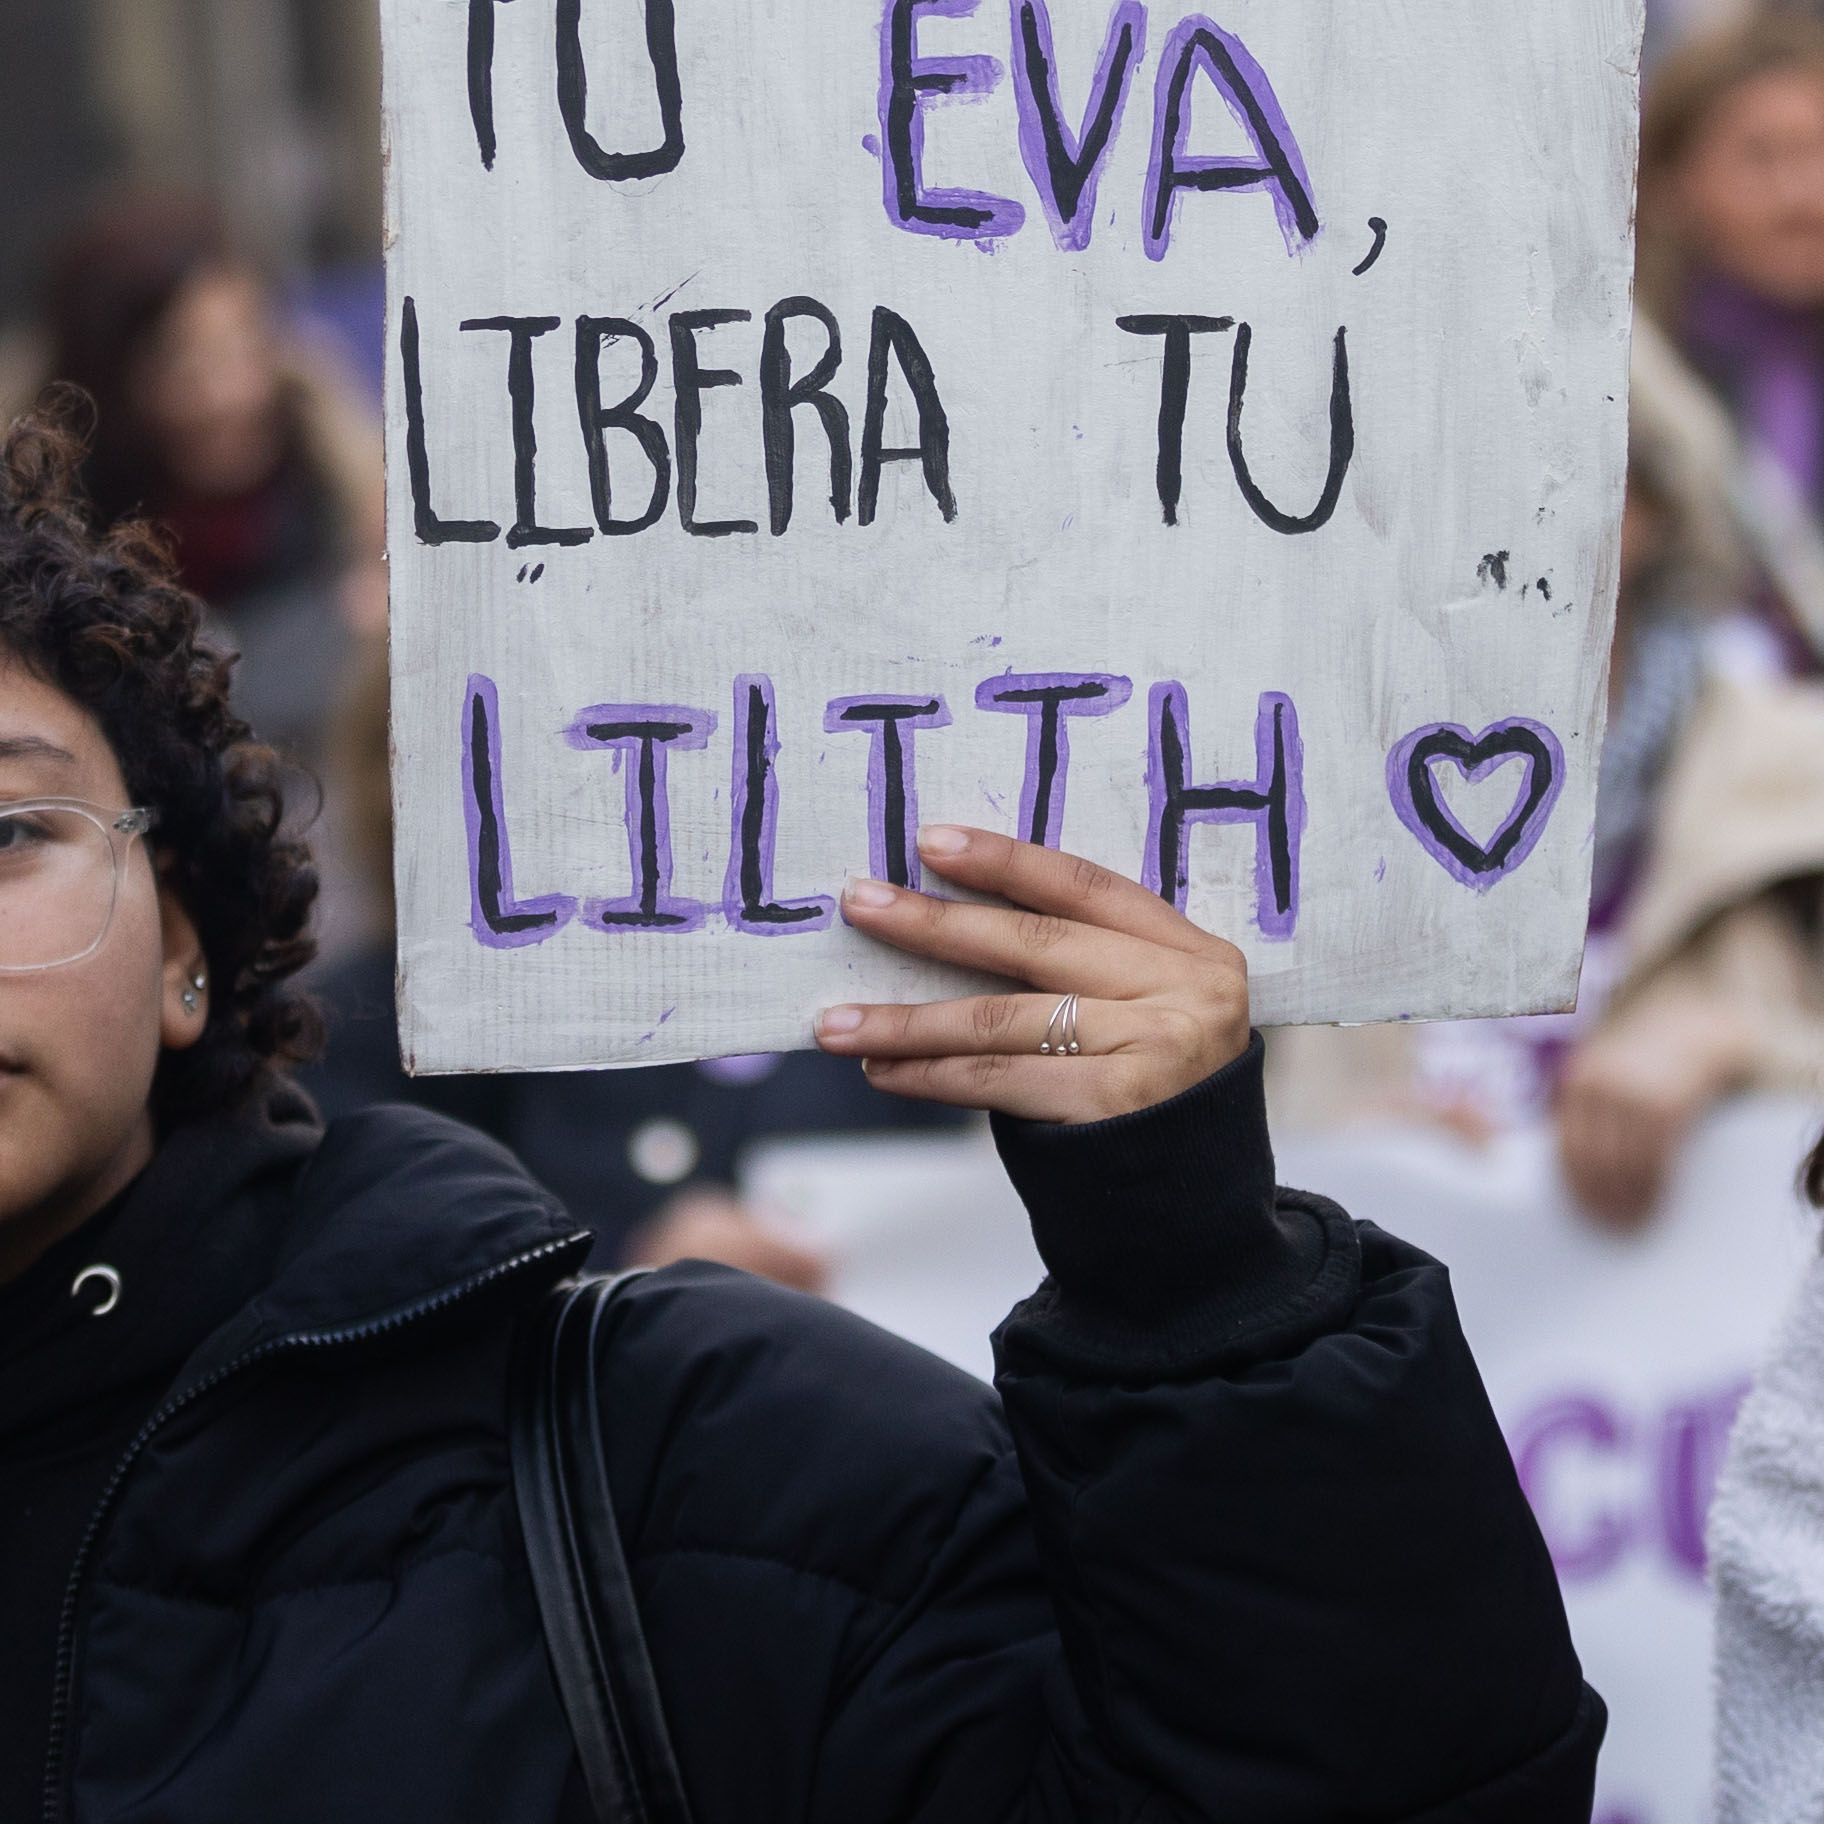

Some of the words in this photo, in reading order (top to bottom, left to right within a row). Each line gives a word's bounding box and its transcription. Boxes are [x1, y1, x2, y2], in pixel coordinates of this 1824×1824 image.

[400, 294, 956, 549] LIBERA
[1115, 314, 1355, 535] TU
[462, 672, 1306, 948] LILITH
